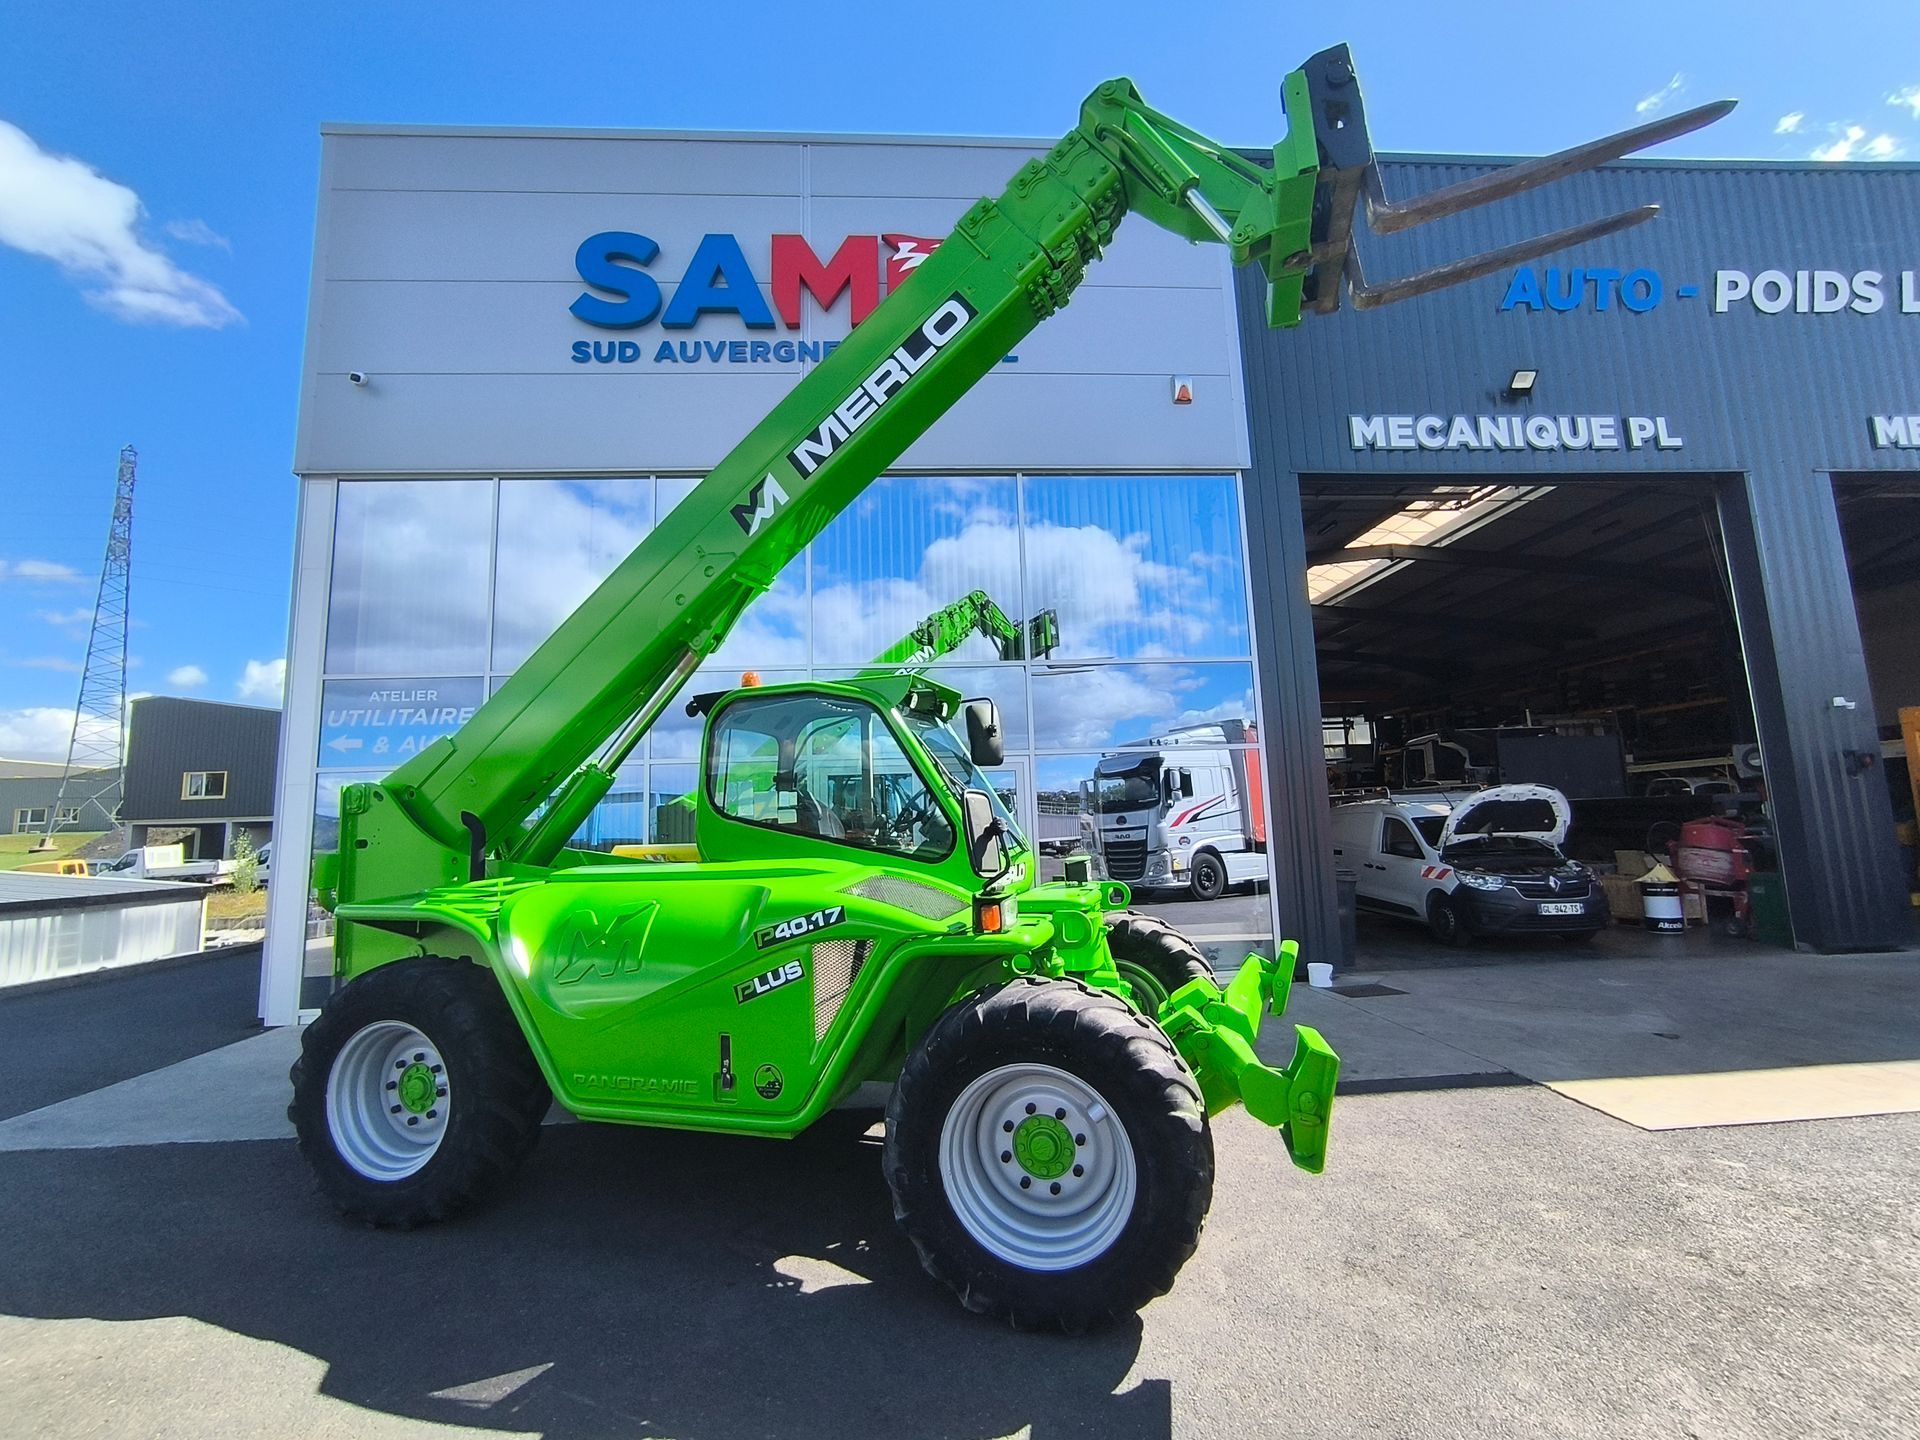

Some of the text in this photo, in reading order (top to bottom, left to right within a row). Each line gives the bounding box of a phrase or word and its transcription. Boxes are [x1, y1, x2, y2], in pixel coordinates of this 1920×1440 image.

[1501, 267, 1662, 312] AUTO
[1716, 270, 1884, 313] POIDS
[571, 341, 641, 363] SUD
[793, 299, 970, 474] MERLO
[1349, 415, 1683, 450] MECANIQUE PL
[369, 690, 438, 702] ATELIER
[373, 736, 389, 753] &
[757, 906, 842, 946] P40.17
[737, 960, 803, 1001] PLUS
[573, 1073, 699, 1096] PANORAMIC
